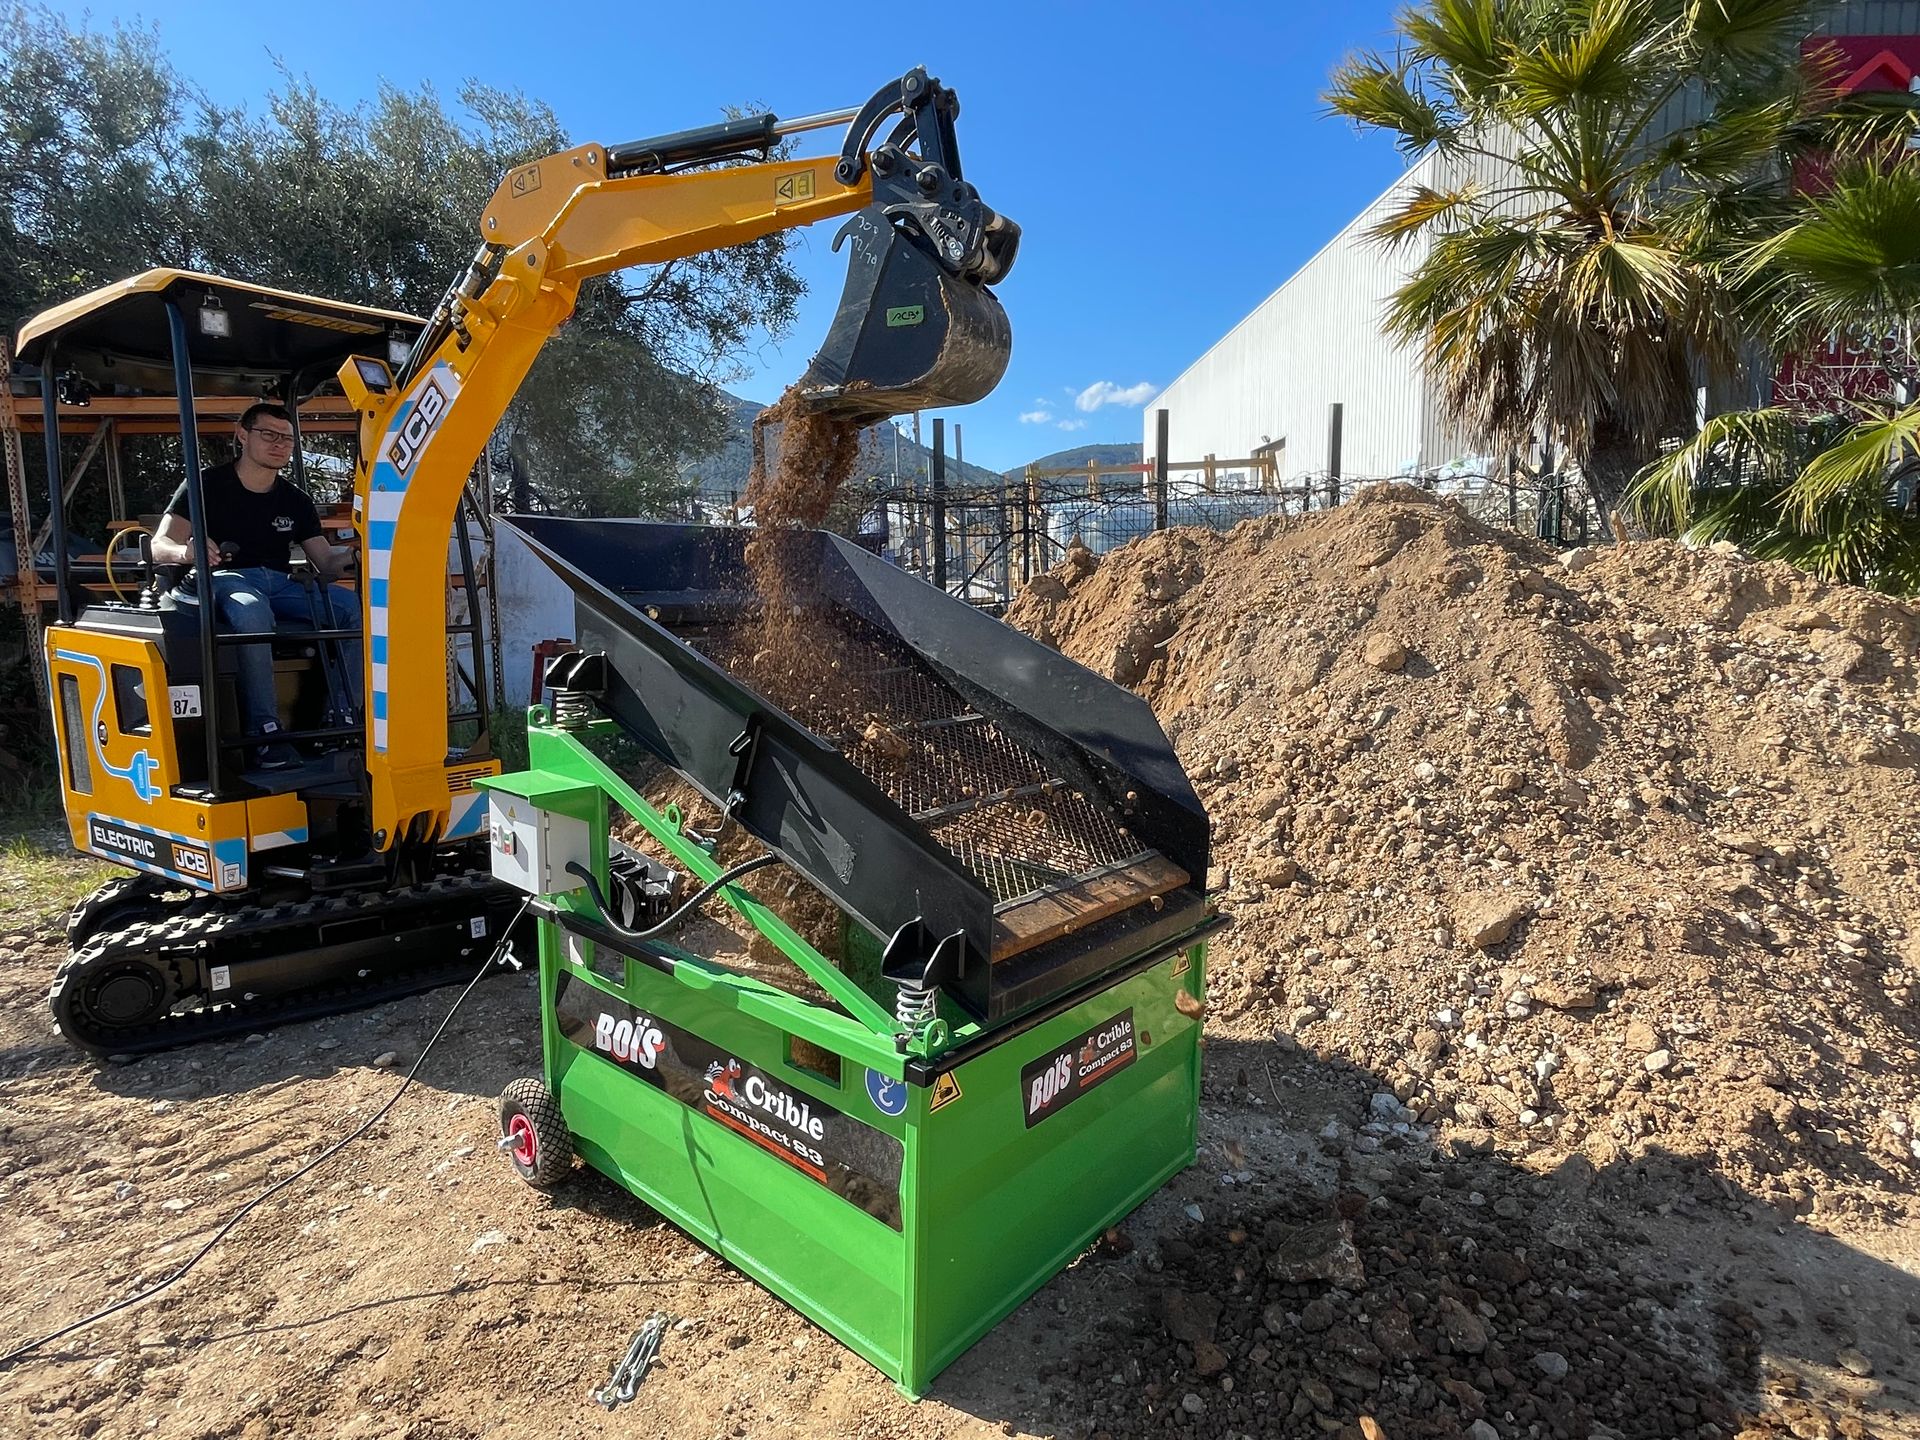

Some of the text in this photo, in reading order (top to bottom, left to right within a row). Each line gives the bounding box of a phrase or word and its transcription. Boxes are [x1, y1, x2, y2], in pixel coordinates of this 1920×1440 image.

[397, 386, 443, 470] JCB
[174, 700, 188, 715] 87
[93, 827, 156, 859] ELECTRIC
[176, 849, 209, 874] JCB
[595, 1012, 664, 1070] BOÏS
[1097, 1021, 1131, 1049] Crible
[1029, 1053, 1072, 1115] BOÏS
[1078, 1050, 1120, 1077] Compact
[704, 1089, 791, 1147] Compact
[792, 1140, 824, 1167] 83
[745, 1076, 824, 1141] Crible
